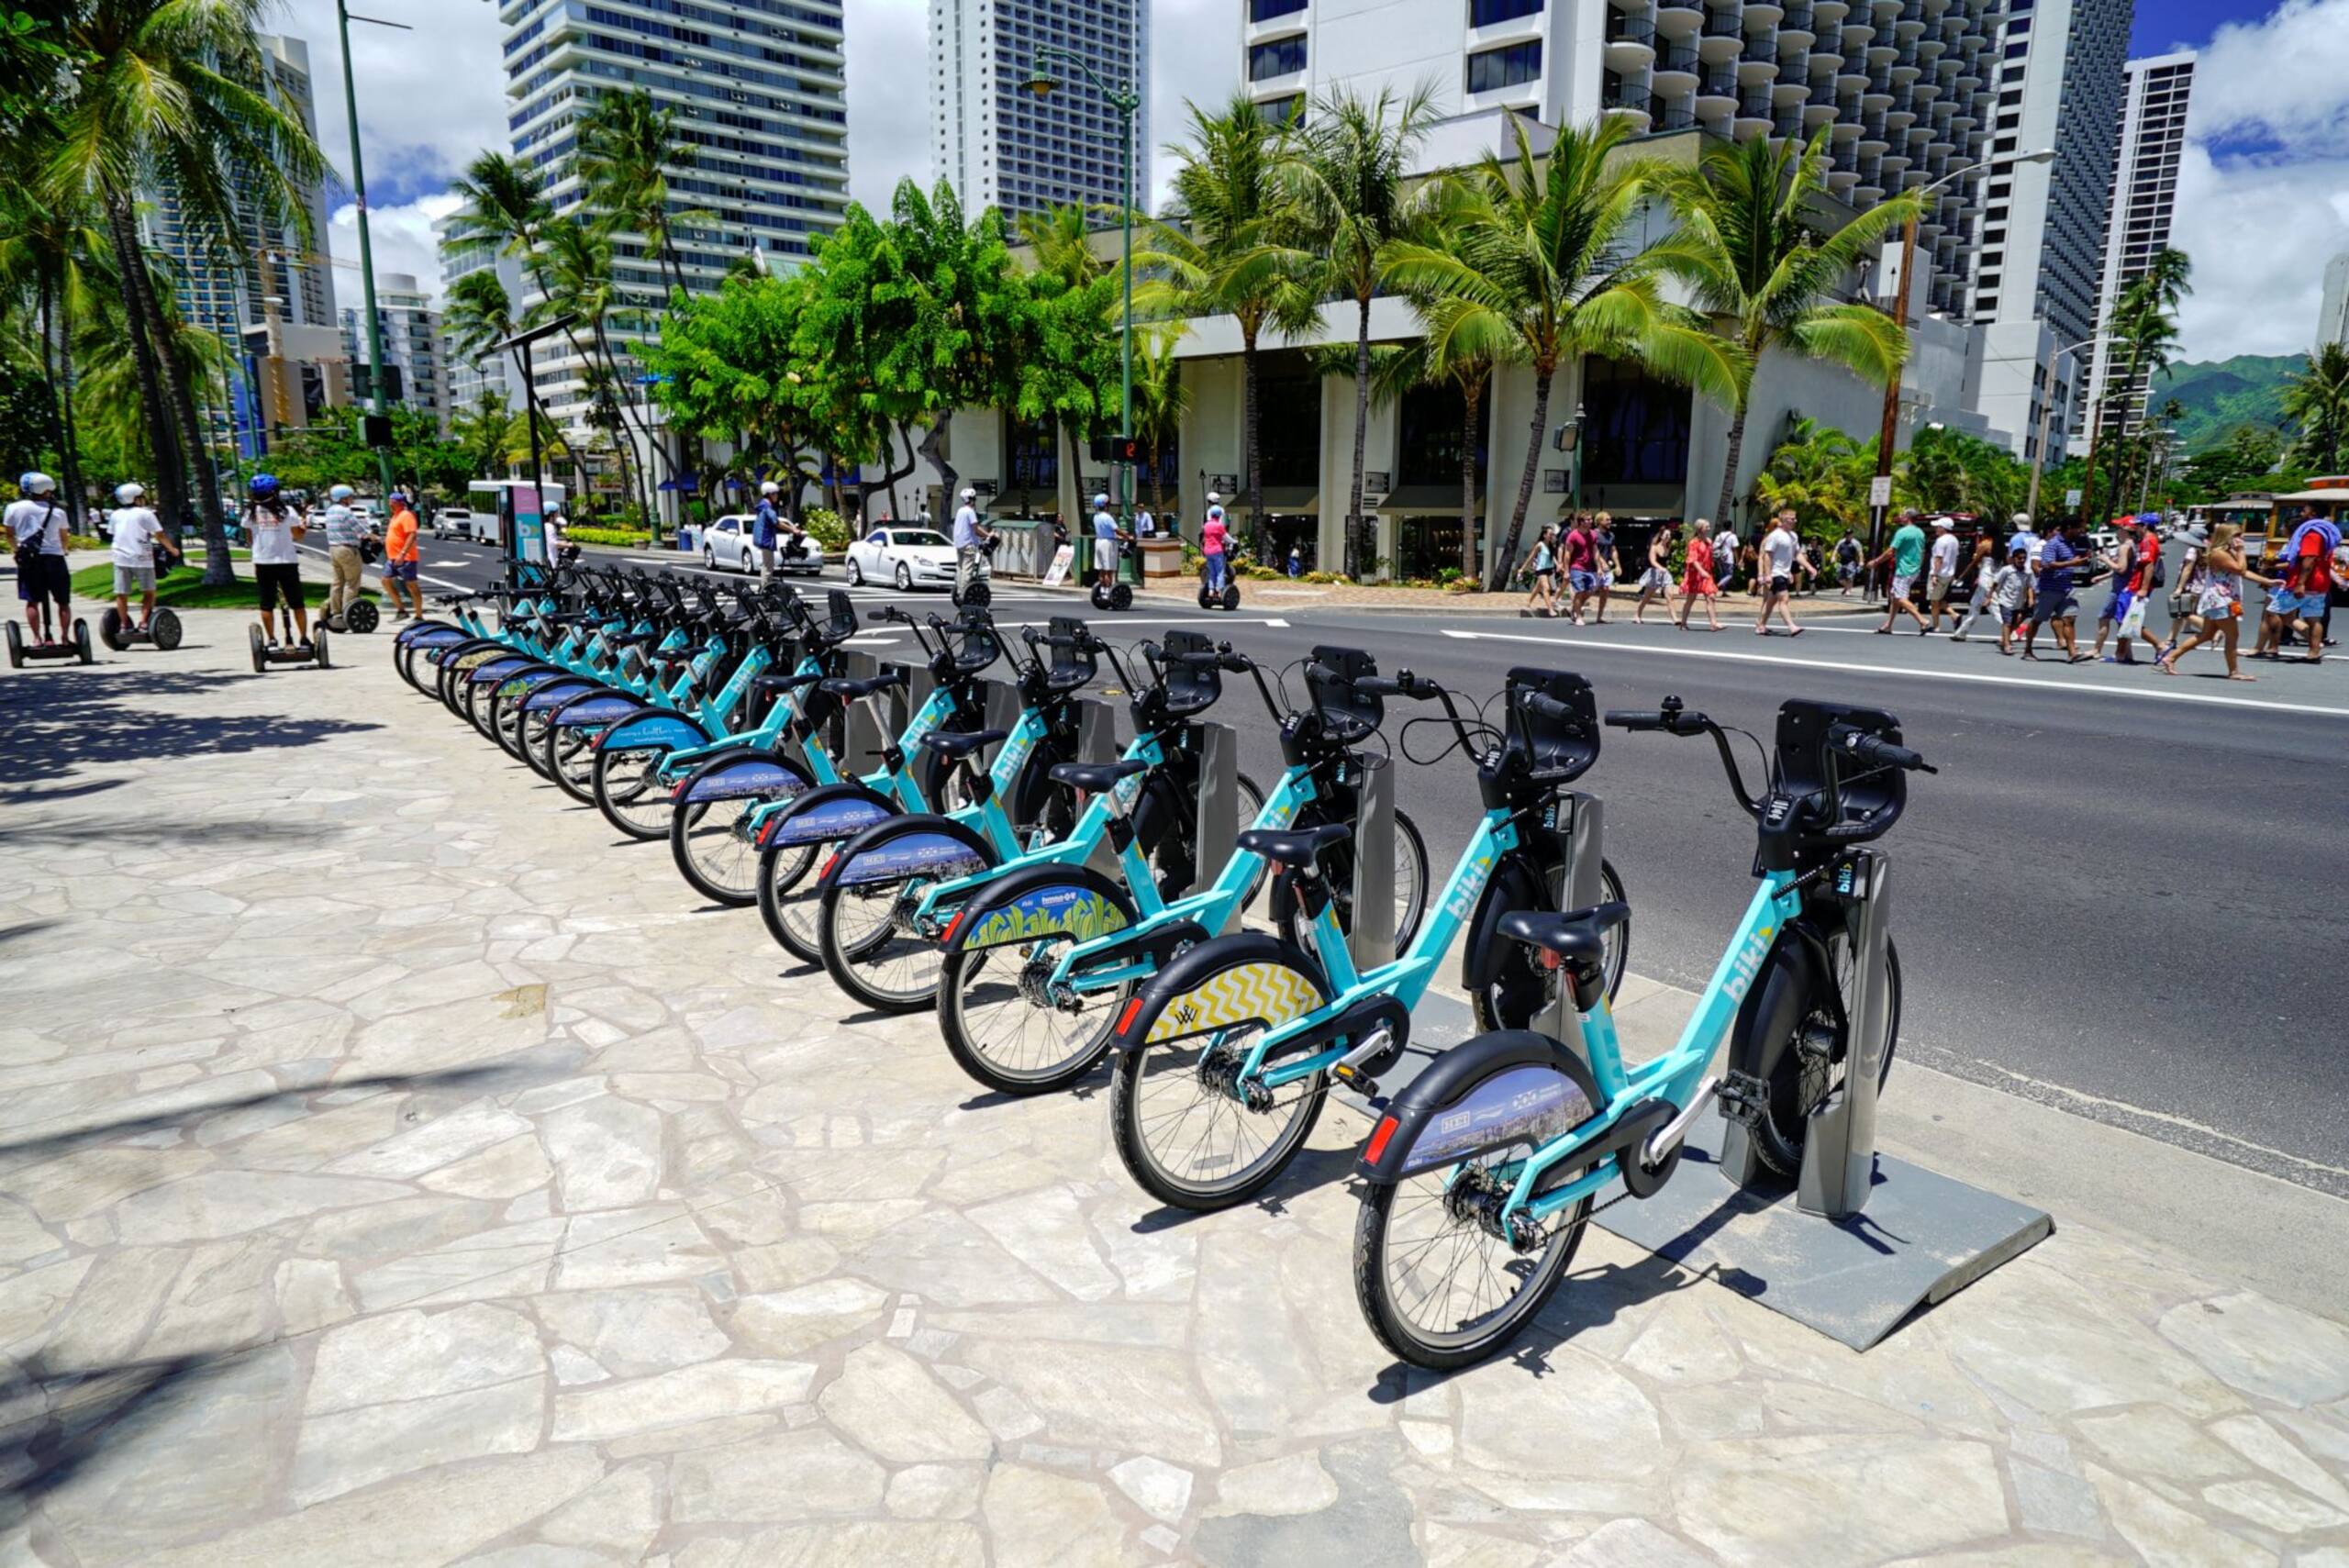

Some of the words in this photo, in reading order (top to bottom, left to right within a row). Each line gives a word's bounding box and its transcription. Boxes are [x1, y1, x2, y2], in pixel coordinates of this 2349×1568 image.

[996, 742, 1027, 782] biki
[1543, 807, 1555, 828] biki
[1445, 861, 1488, 920] biki
[1836, 868, 1853, 893] biki
[1721, 932, 1768, 1005] biki
